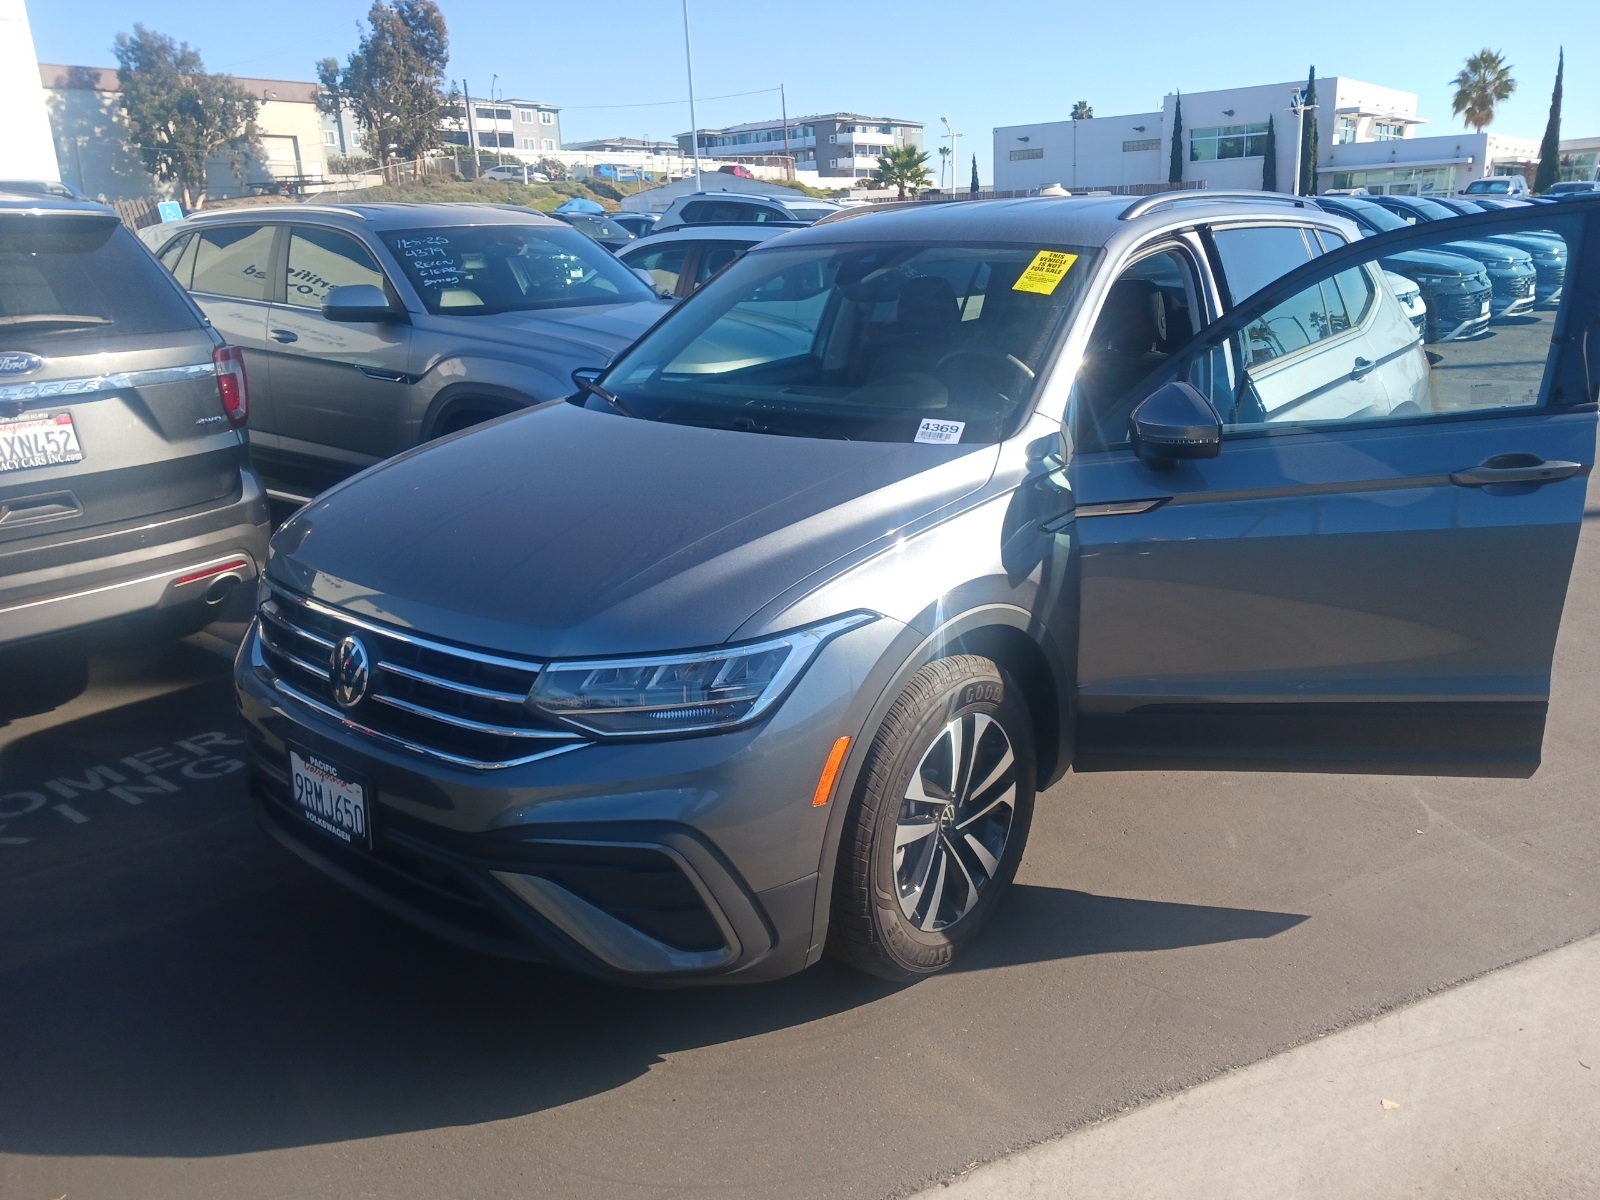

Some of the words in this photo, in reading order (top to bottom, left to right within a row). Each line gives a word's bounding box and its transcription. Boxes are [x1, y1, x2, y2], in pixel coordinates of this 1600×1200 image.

[405, 247, 447, 257] 4379
[1040, 256, 1068, 265] VEHICLE
[1045, 267, 1063, 275] SALE
[0, 356, 29, 370] Ford
[921, 422, 960, 434] 4369
[21, 455, 47, 468] CARS
[309, 755, 338, 777] PACIFIC
[295, 772, 364, 836] 9RMJ650
[305, 810, 351, 842] VOLKSWAGEN
